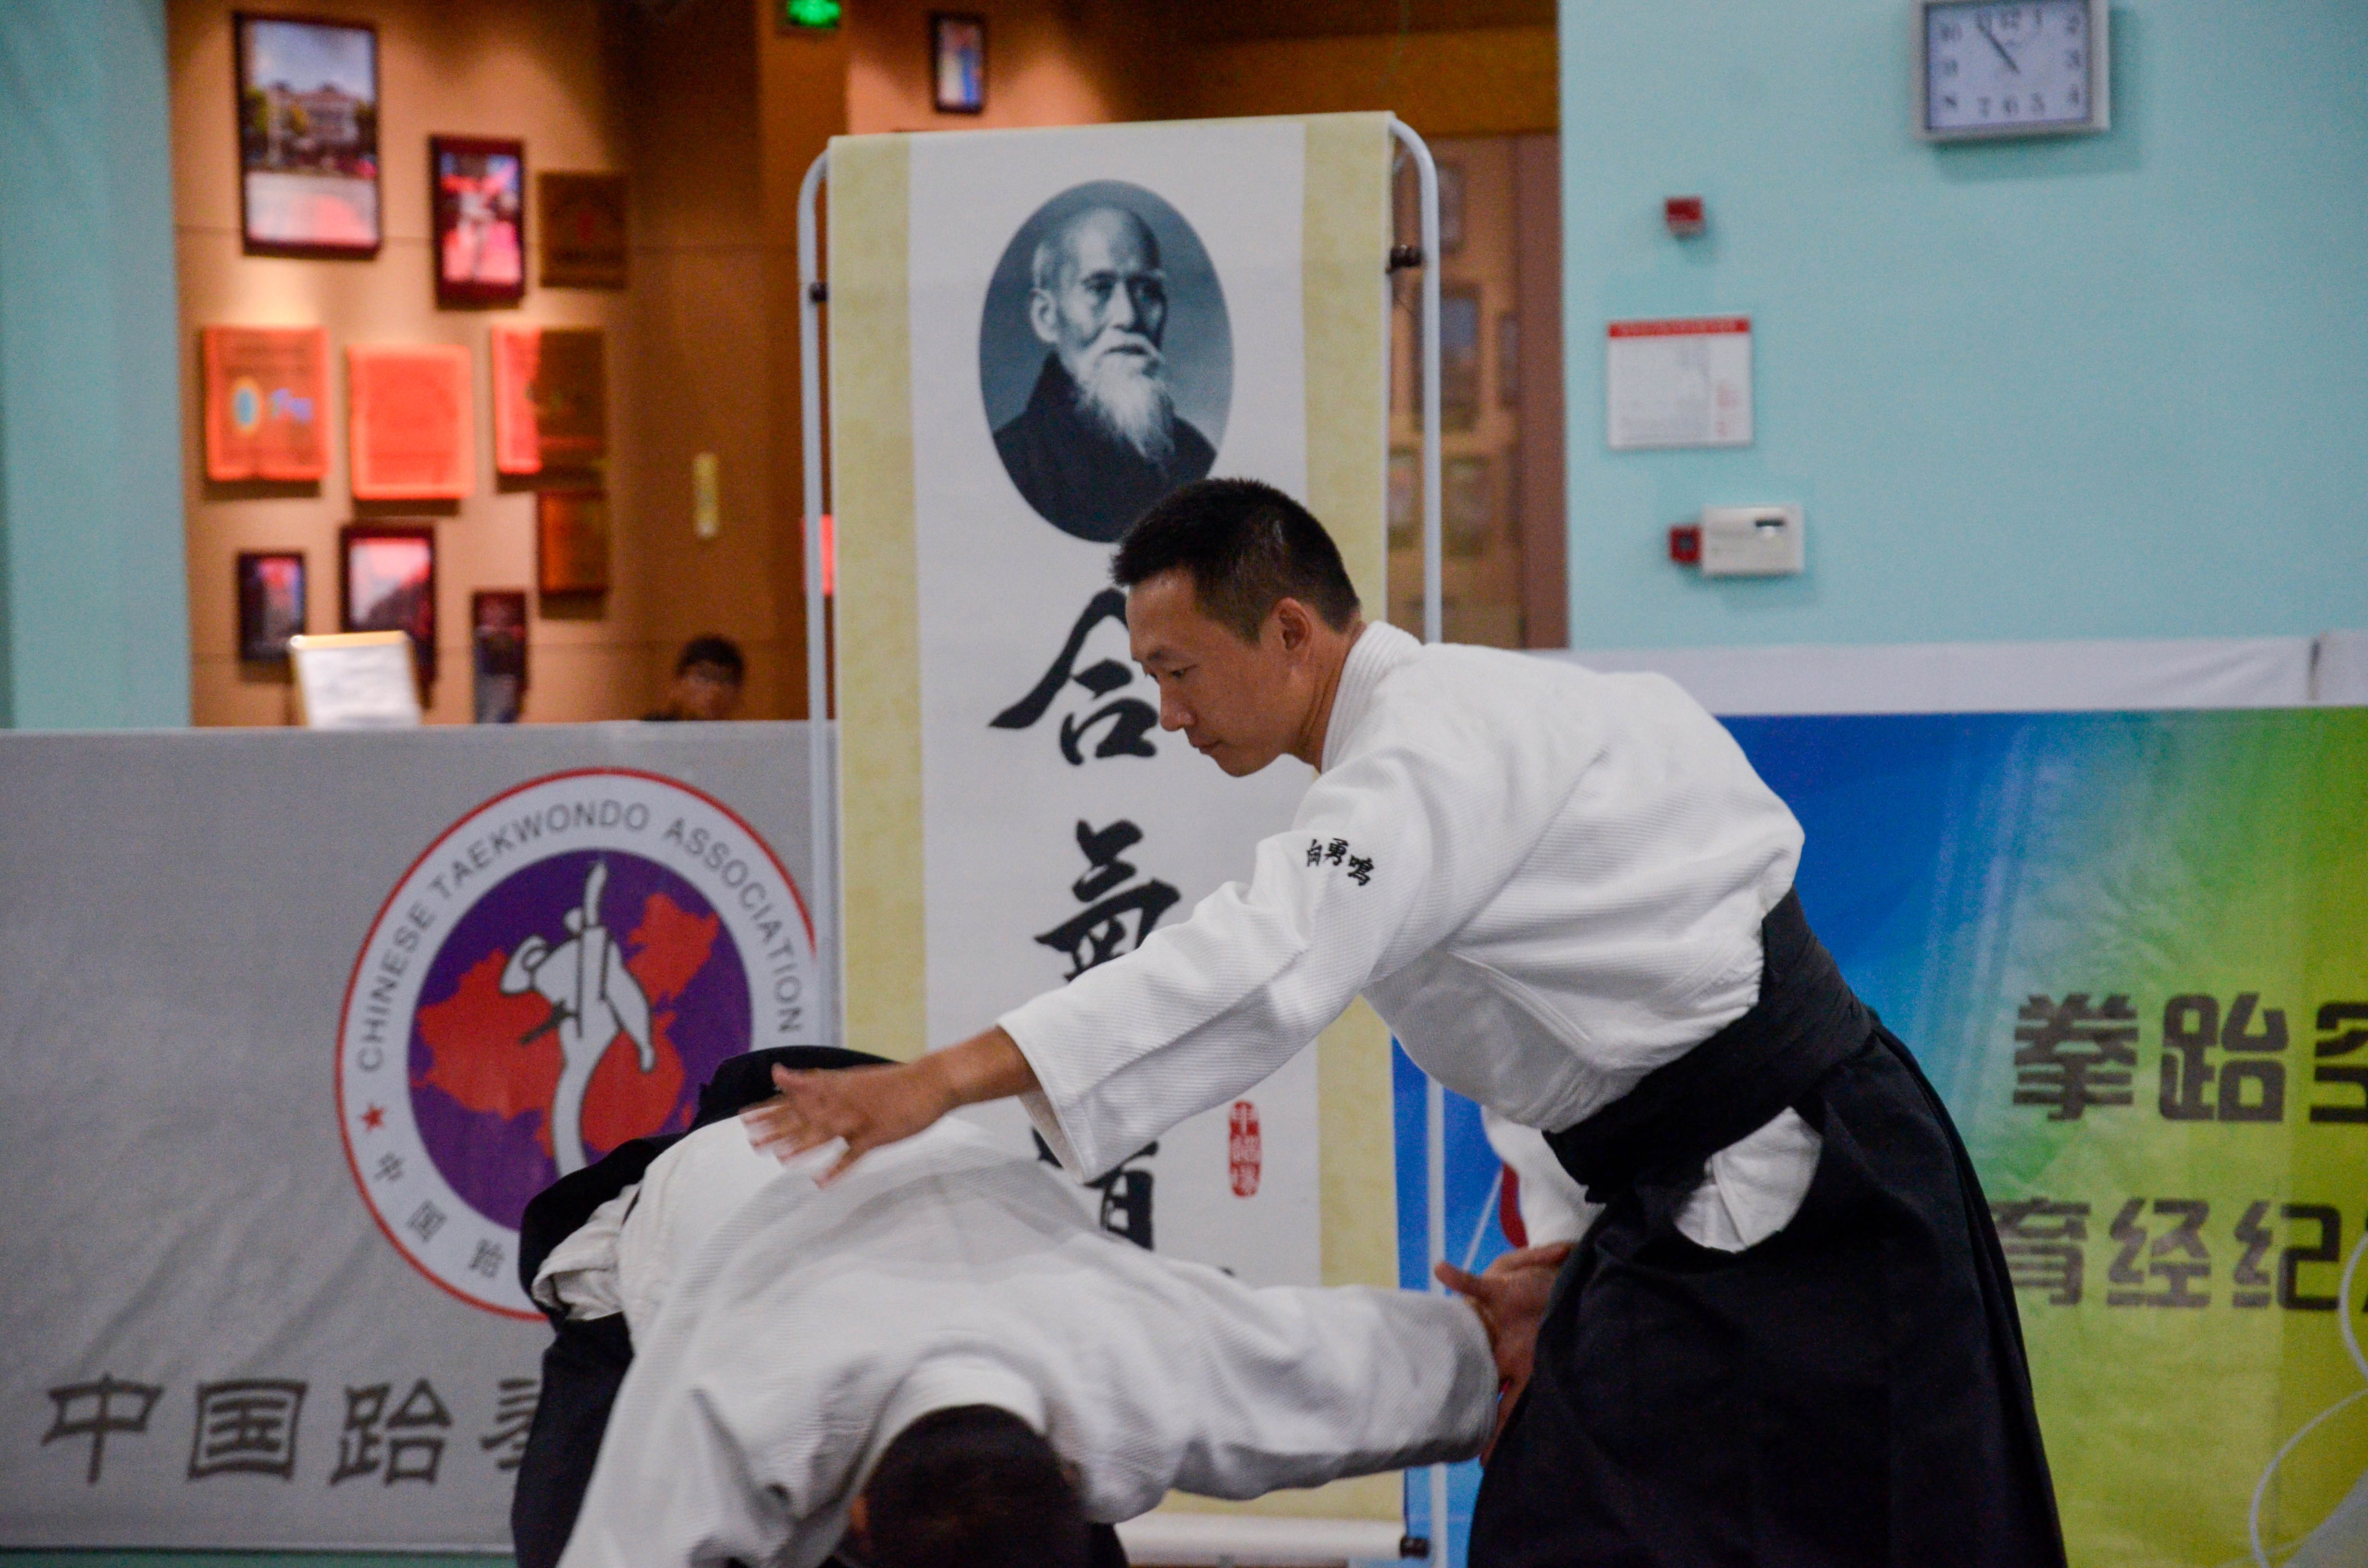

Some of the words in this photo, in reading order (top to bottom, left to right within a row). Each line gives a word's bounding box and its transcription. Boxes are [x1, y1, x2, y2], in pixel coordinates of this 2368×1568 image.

[357, 902, 436, 1073] CHINESE
[431, 798, 651, 898] TAEKWONDO
[661, 816, 803, 1035] ASSOCIATION
[1990, 1196, 2368, 1312] 育经纪
